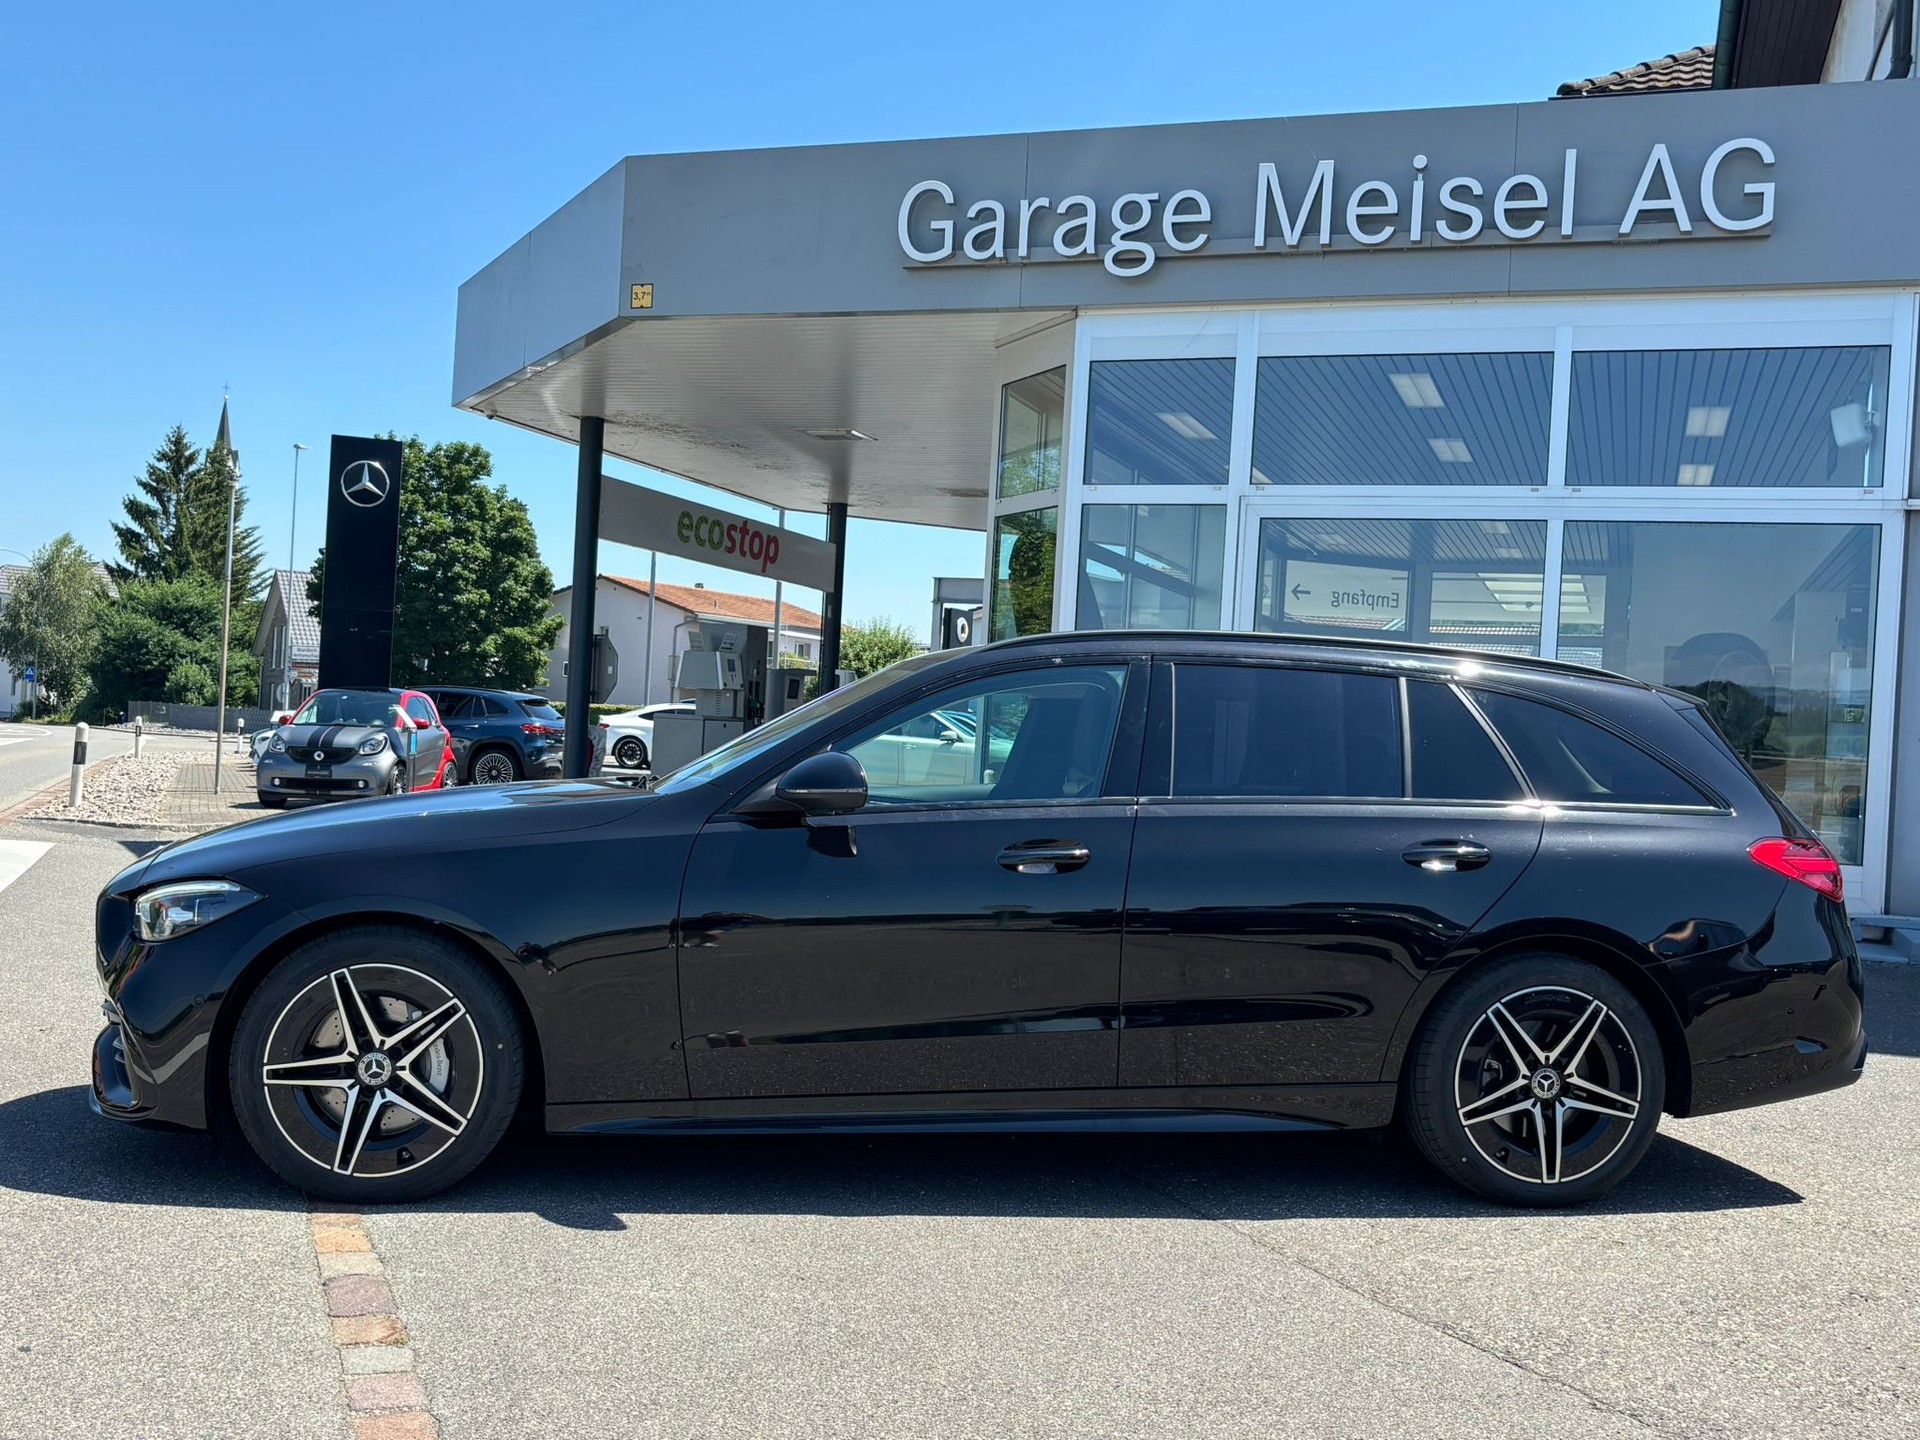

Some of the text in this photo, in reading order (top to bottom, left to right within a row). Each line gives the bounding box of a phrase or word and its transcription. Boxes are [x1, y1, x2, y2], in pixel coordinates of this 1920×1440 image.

[898, 137, 1776, 277] Garage Meisel AG
[677, 510, 780, 573] ecostop
